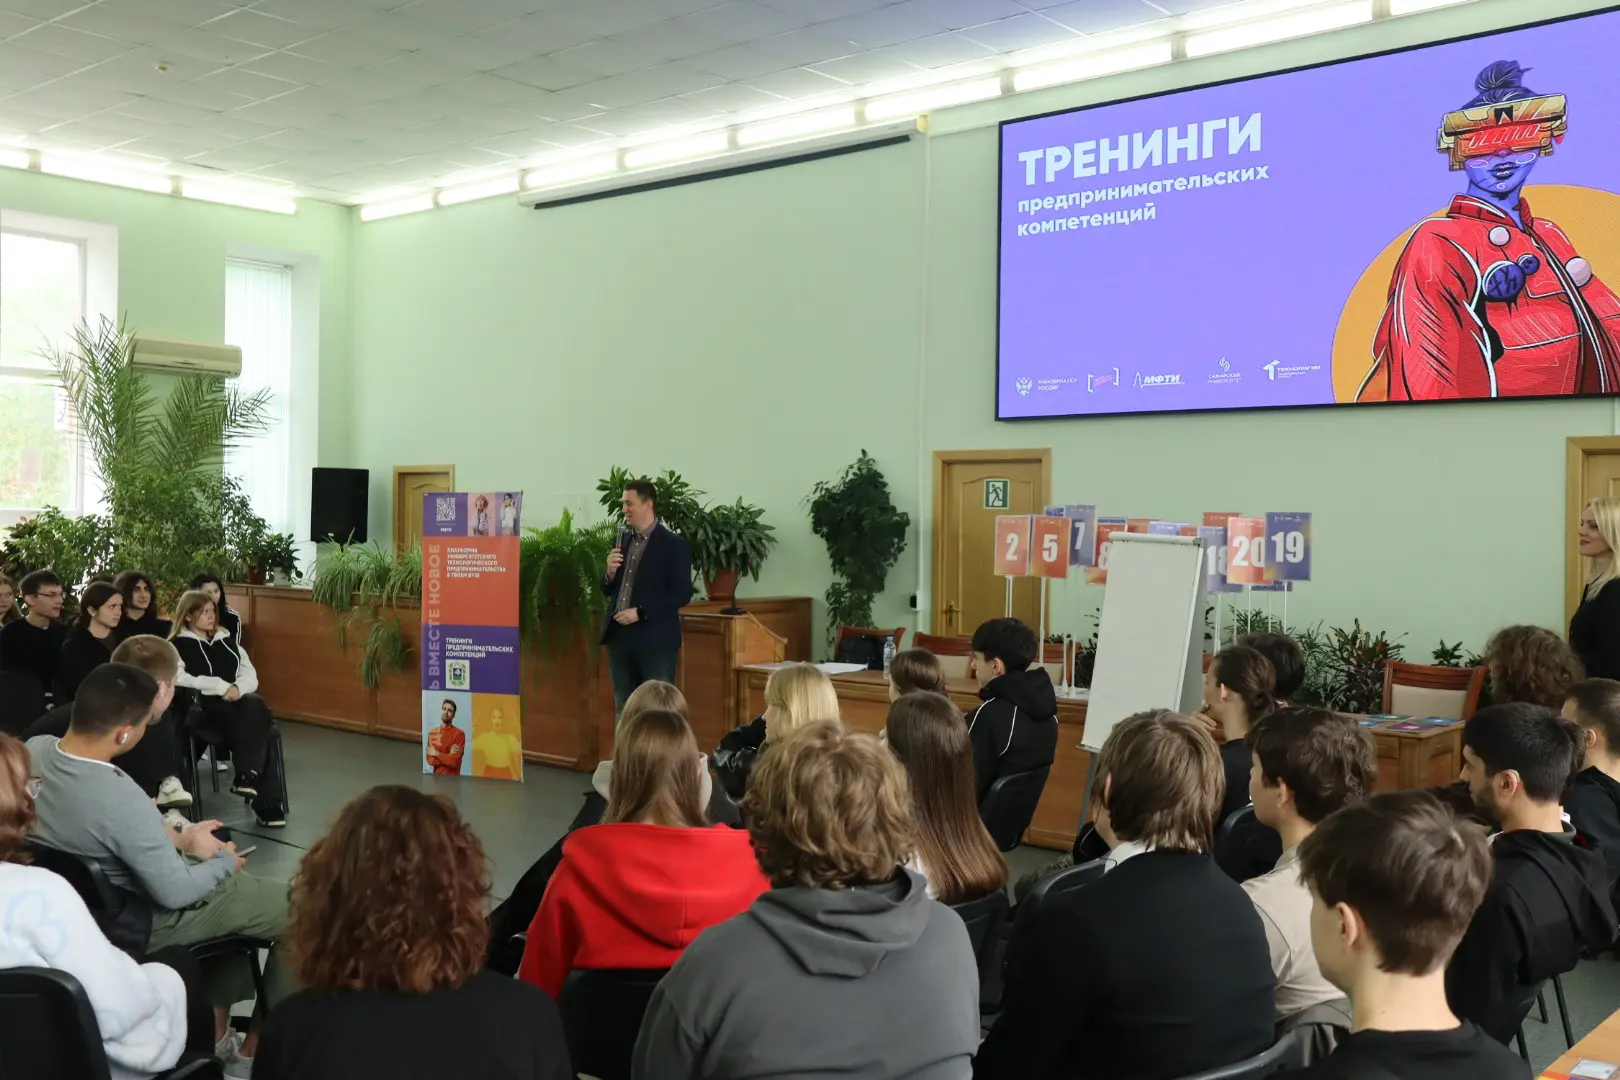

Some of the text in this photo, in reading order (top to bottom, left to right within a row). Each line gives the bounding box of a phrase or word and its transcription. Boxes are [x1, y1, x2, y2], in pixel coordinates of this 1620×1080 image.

[1018, 112, 1262, 185] ТРЕНИНГИ
[1018, 165, 1269, 215] предпринимательских
[1017, 203, 1156, 236] компетенций
[1144, 374, 1180, 385] МФТИ
[1006, 533, 1019, 561] 2
[1042, 533, 1058, 562] 5
[1074, 521, 1085, 550] 7
[1232, 535, 1265, 568] 20
[1271, 531, 1304, 563] 19
[428, 544, 440, 604] НОВОЕ
[428, 608, 440, 676] ВМЕСТЕ
[446, 644, 514, 653] ПРЕДПРИНИМАТЕЛЬСКИХ
[446, 650, 486, 658] КОМПЕТЕНЦИЙ
